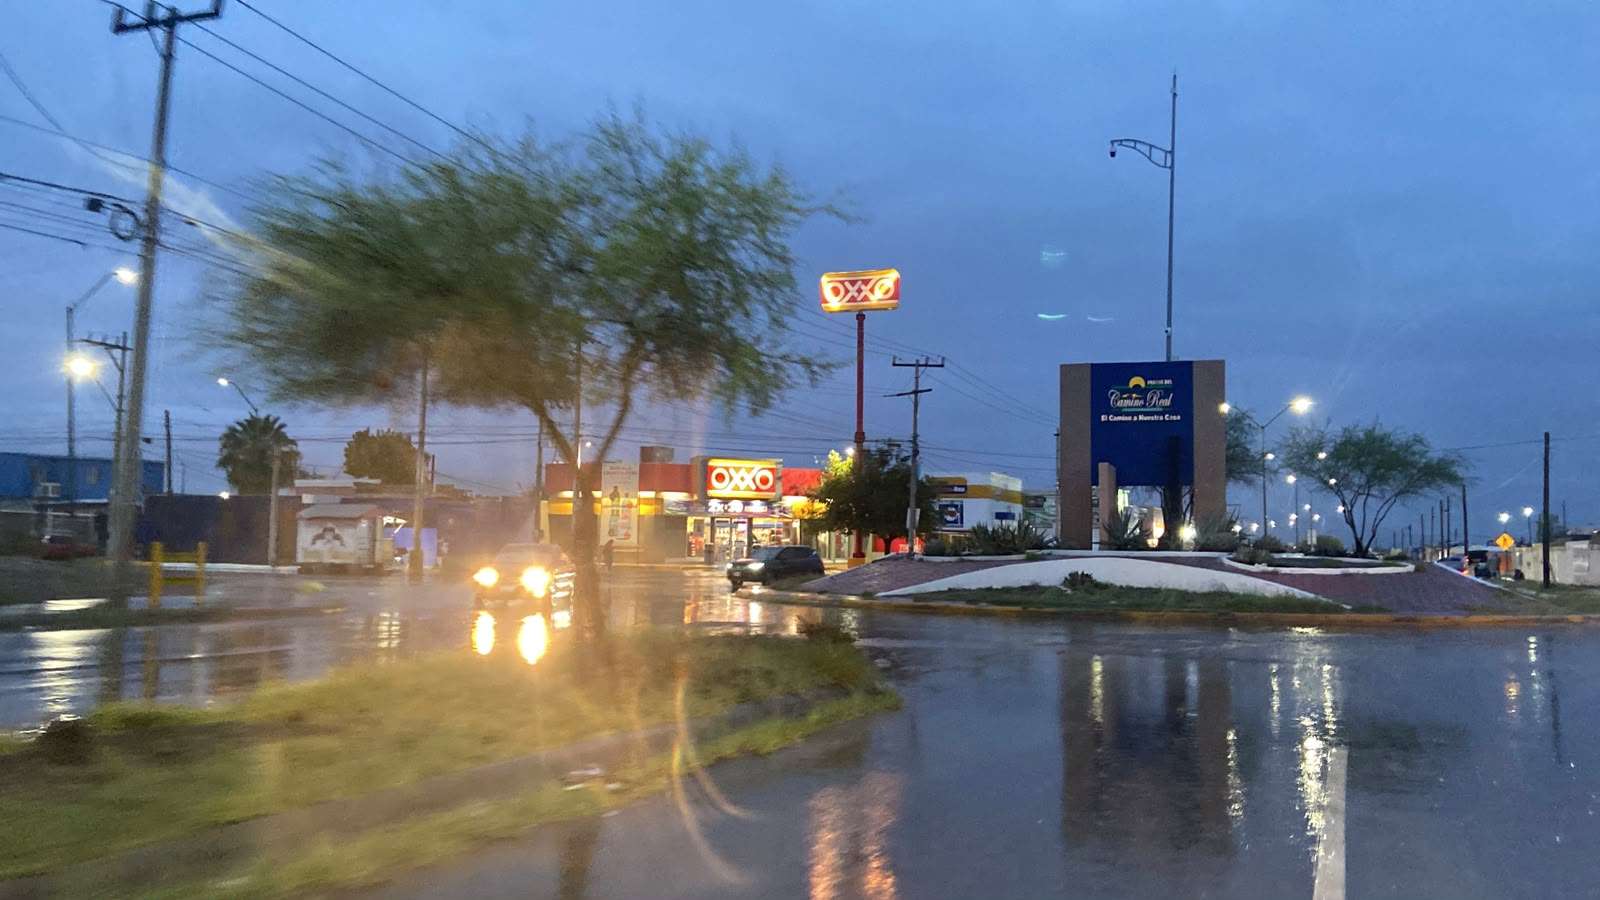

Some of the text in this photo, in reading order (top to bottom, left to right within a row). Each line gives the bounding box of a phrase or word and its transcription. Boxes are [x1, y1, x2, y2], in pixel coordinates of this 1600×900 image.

[824, 278, 895, 304] OXXO
[1108, 389, 1173, 408] Camino Real
[711, 466, 774, 490] OXXO
